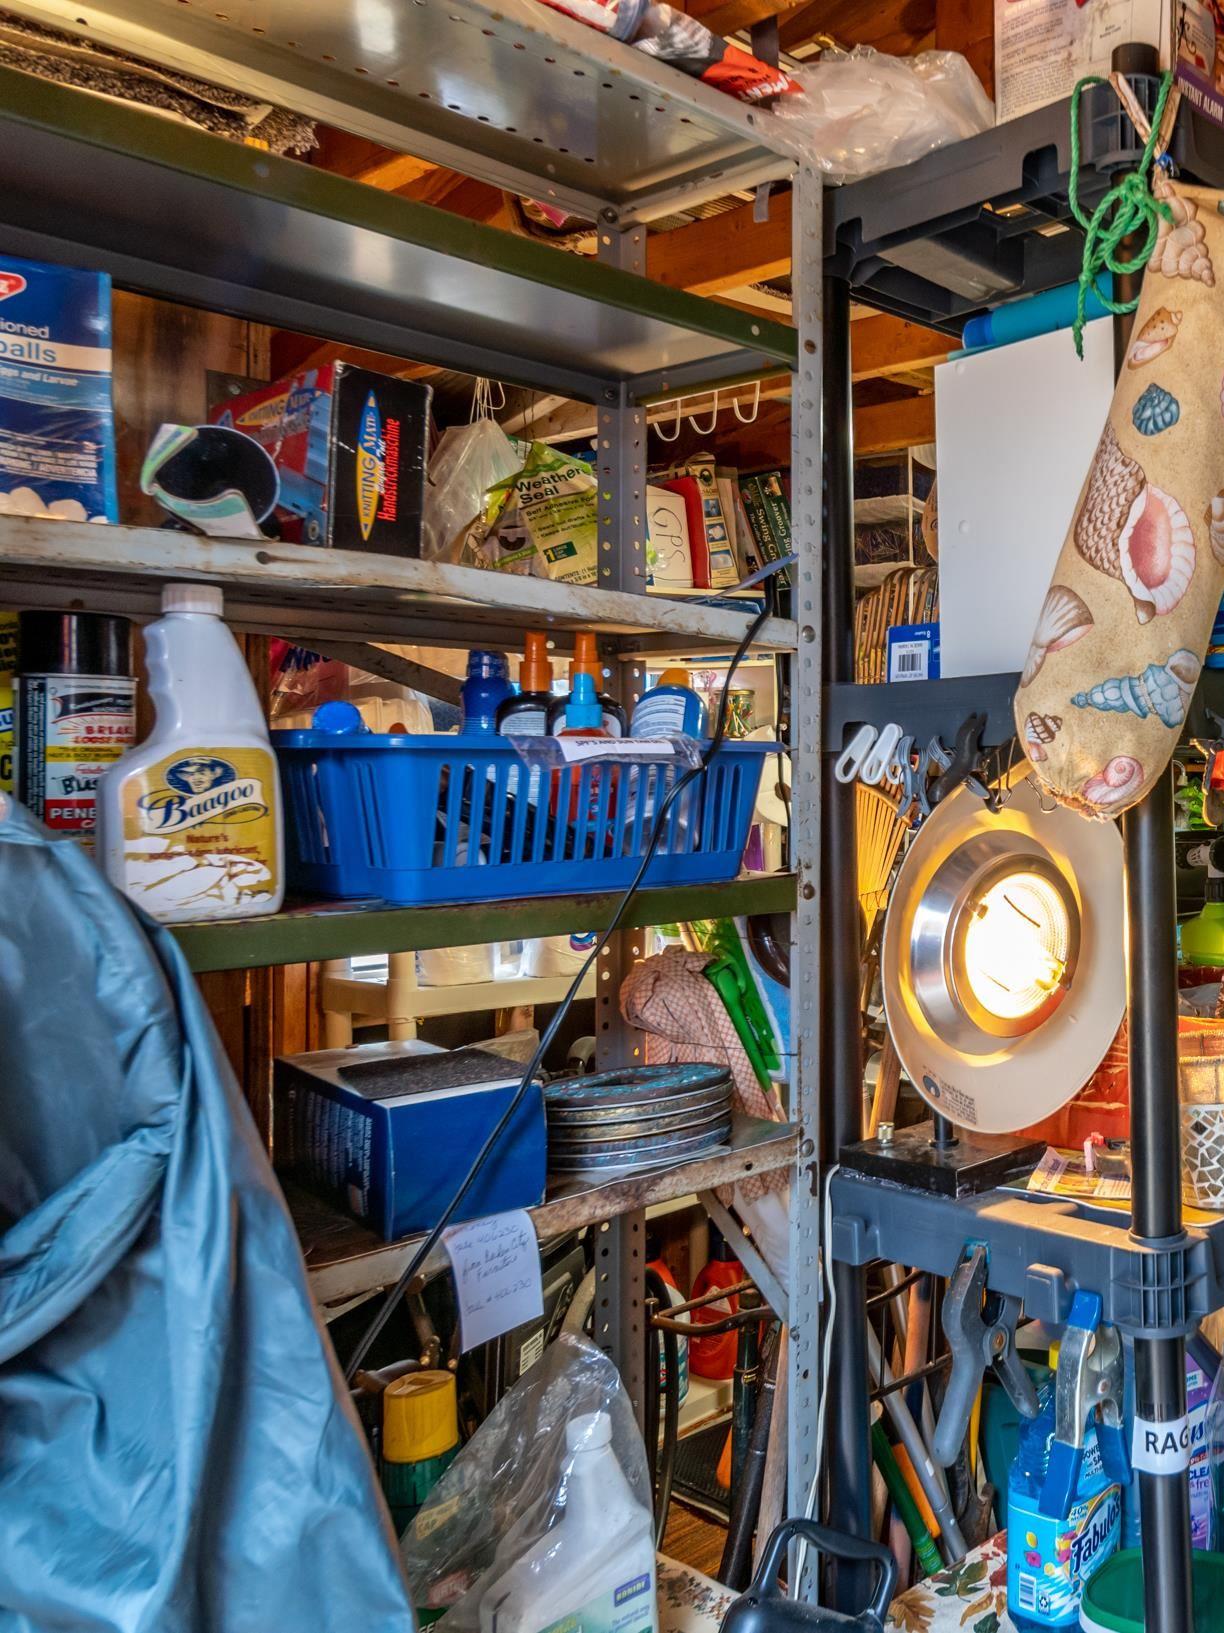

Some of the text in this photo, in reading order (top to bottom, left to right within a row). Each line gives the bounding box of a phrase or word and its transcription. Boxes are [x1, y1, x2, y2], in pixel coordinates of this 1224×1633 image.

[1178, 76, 1202, 107] INSTANT
[1203, 98, 1222, 125] ALARM
[361, 457, 377, 517] KNITTING
[377, 417, 400, 522] Handstrickmaschine
[516, 467, 582, 493] Weather
[520, 486, 560, 505] Seal
[756, 508, 771, 542] Swing
